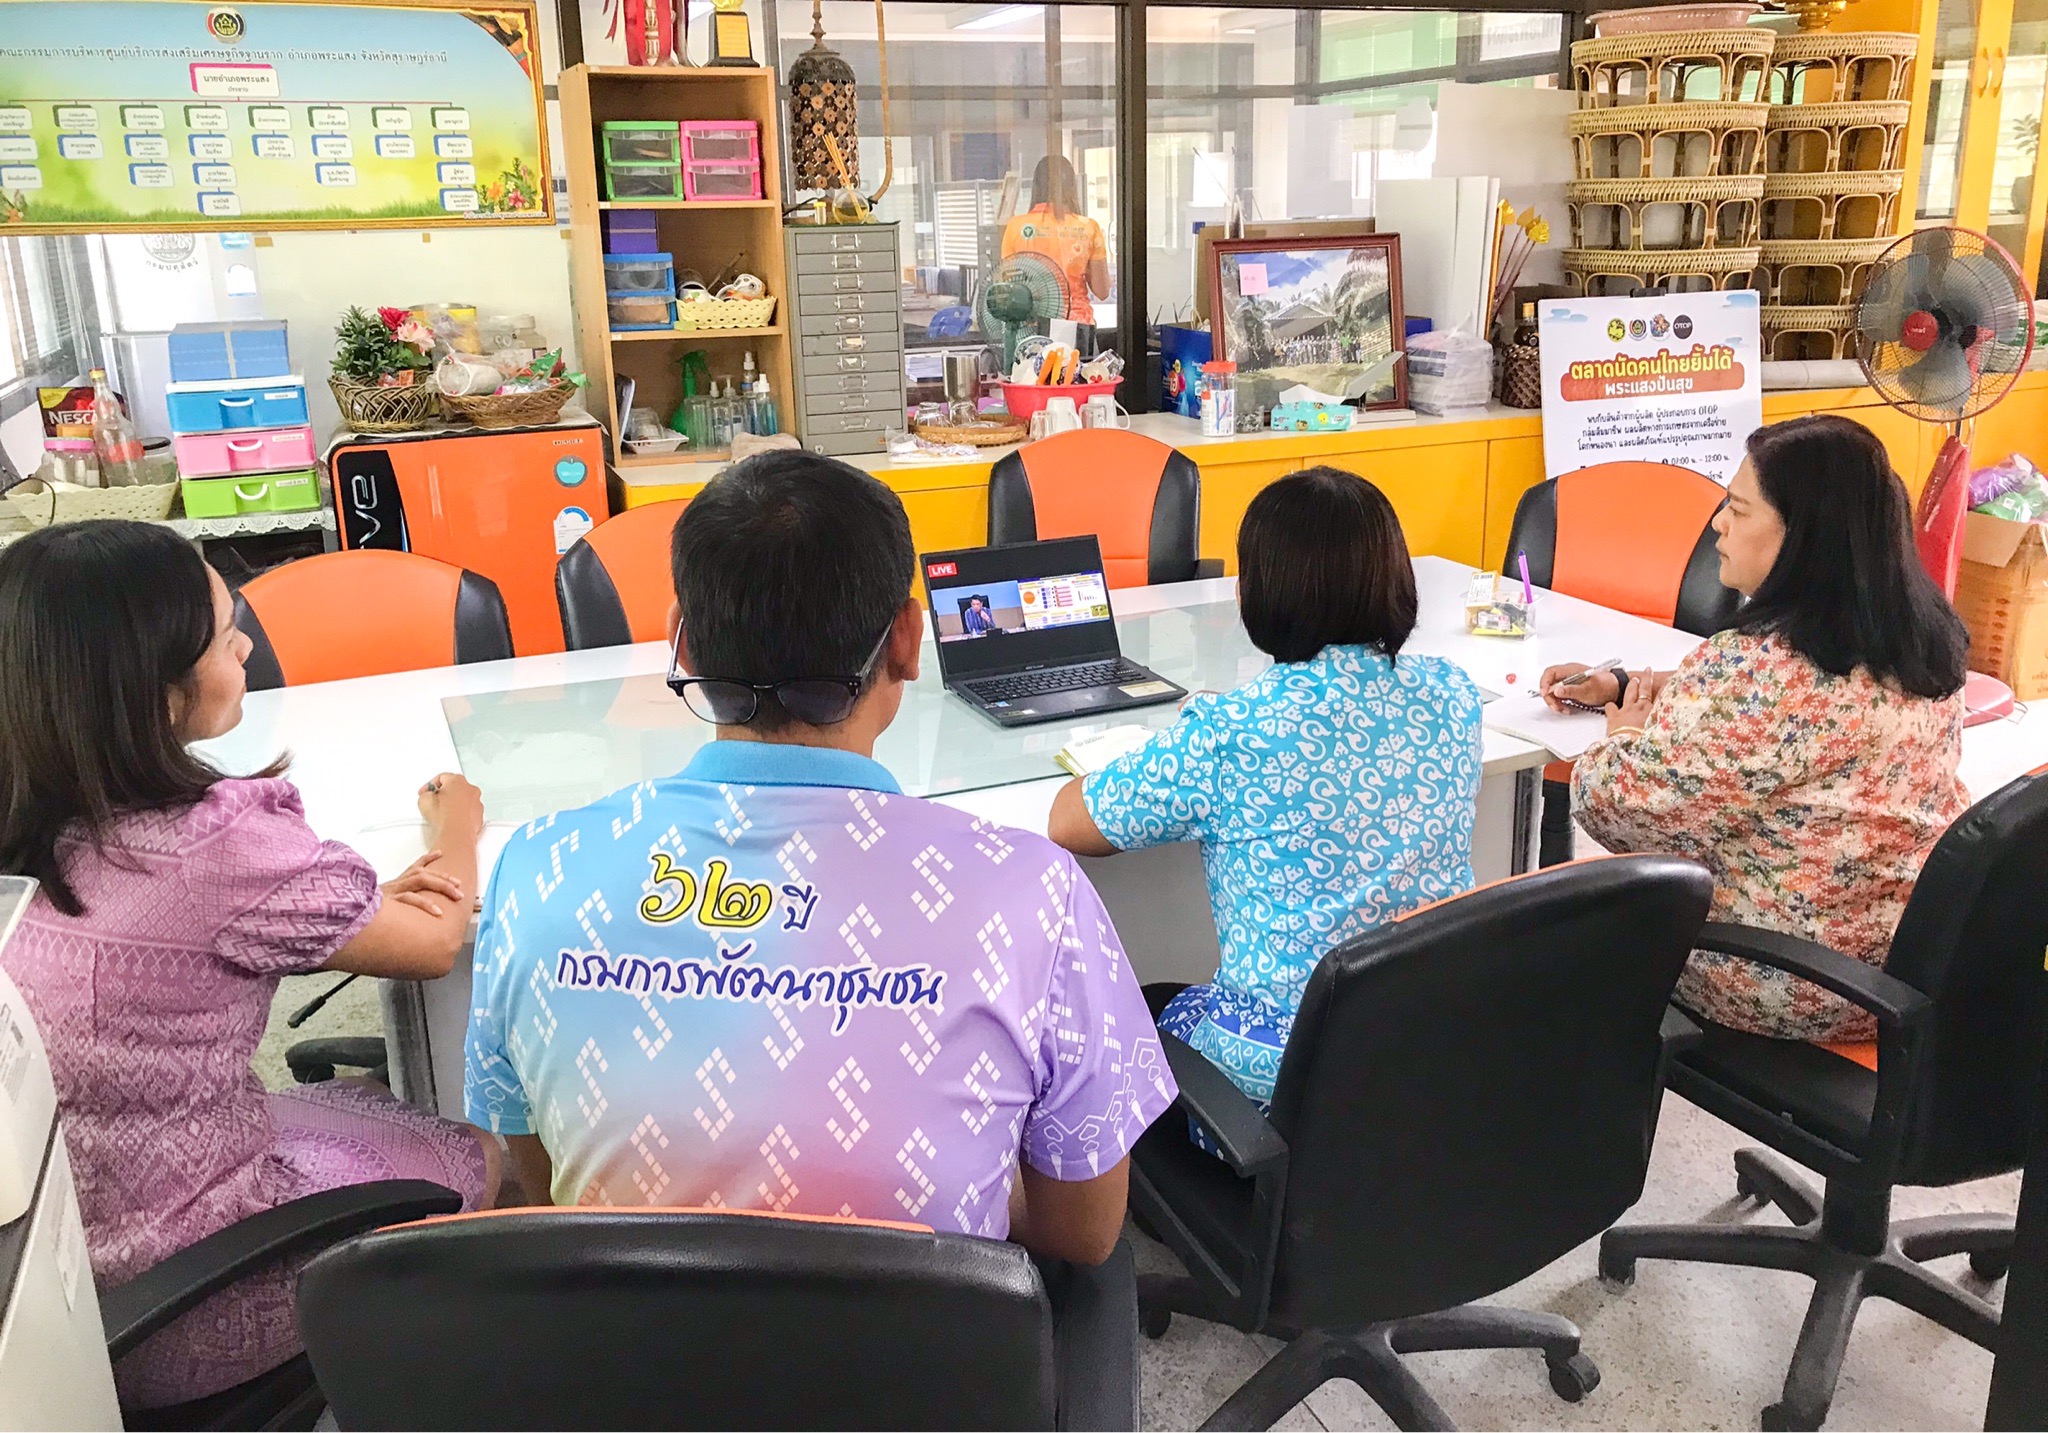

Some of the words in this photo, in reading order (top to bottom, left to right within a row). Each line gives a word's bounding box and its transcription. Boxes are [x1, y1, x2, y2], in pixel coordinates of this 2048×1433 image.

[288, 49, 357, 61] อำเภอพระแสง
[361, 50, 448, 65] จังหวัดสุราษฎร์ธานี
[1674, 322, 1692, 330] OTOP
[1571, 346, 1733, 380] ตลาดนัดคนไทยยิ้มได้
[1605, 375, 1694, 396] พระแสงปันสุข
[48, 410, 98, 425] NESCA
[1698, 405, 1719, 415] OTOP
[1705, 454, 1722, 463] 12:00
[931, 565, 953, 575] LIVE
[640, 853, 772, 928] ๖๒
[781, 883, 818, 930] ปี
[557, 943, 943, 1031] กรมการพัฒนาชุมชน
